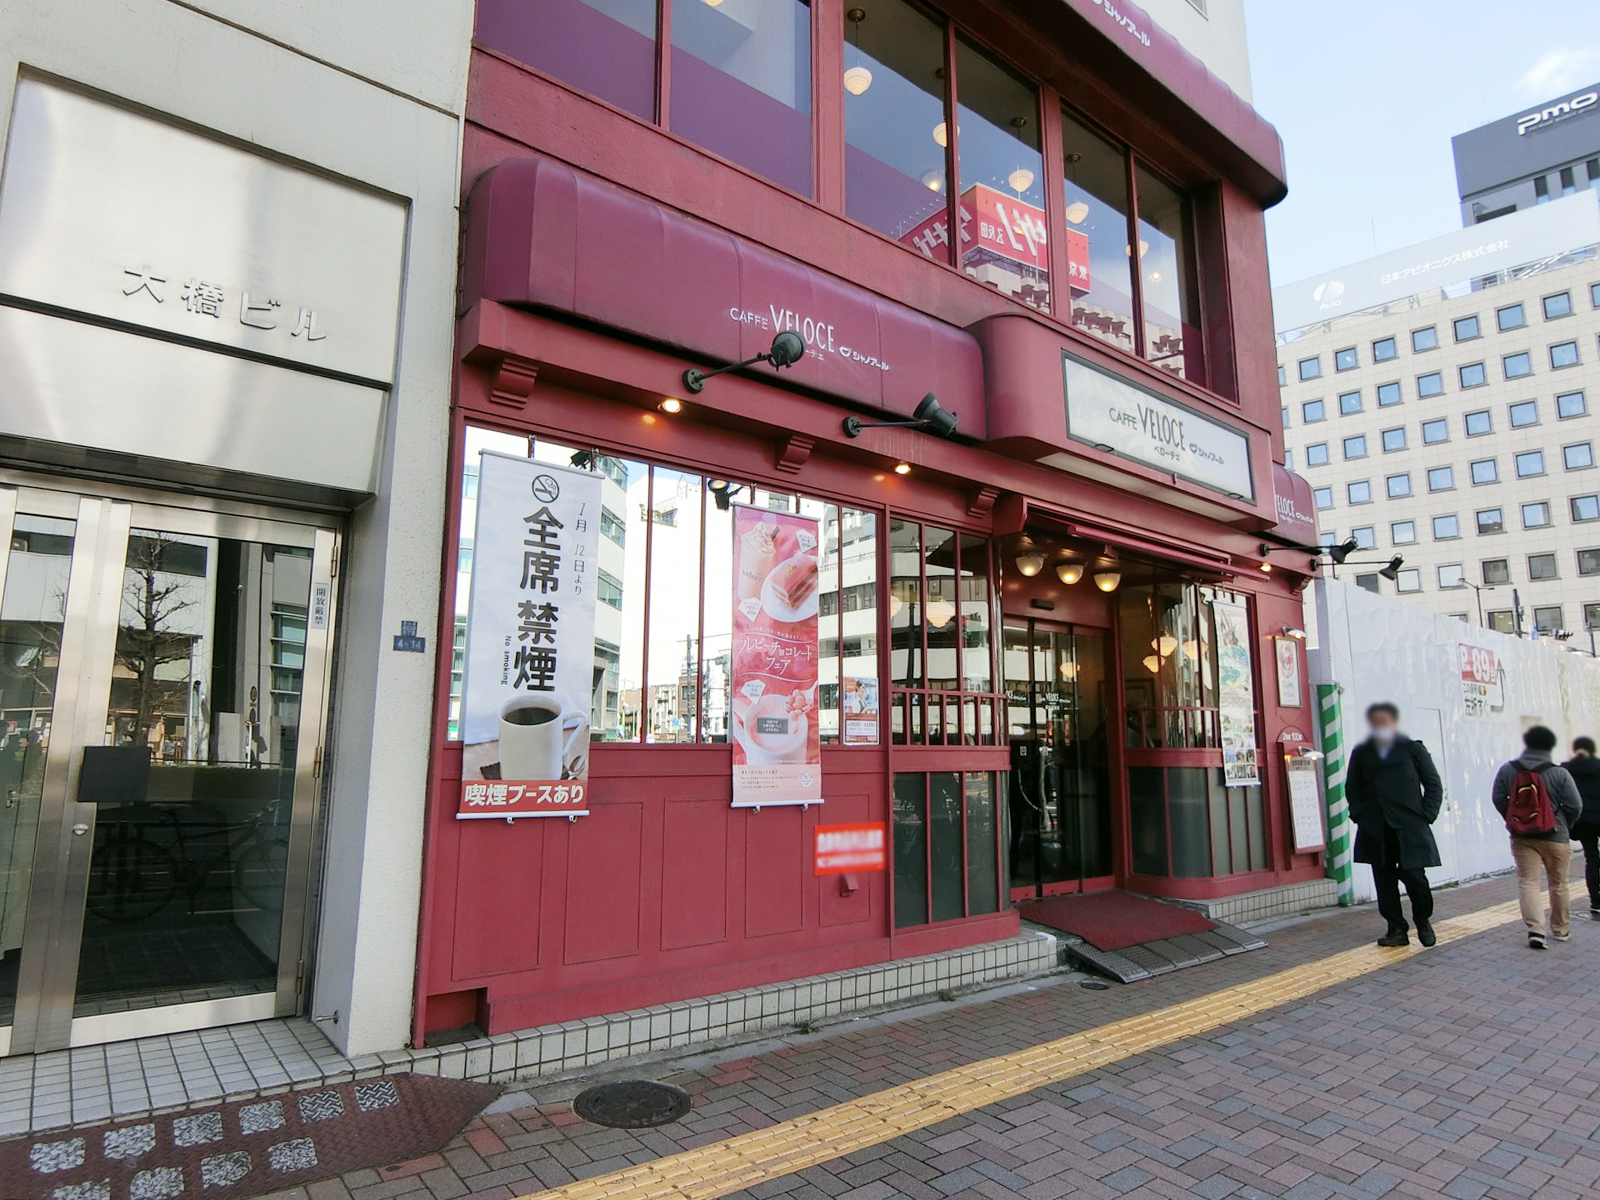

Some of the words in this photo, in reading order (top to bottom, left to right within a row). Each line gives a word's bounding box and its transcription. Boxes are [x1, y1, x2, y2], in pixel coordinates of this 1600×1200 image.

[122, 264, 327, 342] 大橋ビル
[729, 307, 769, 331] CAFFE
[852, 351, 890, 371] シャノアール
[1109, 407, 1138, 431] CAFFE
[1137, 403, 1186, 452] VELOCE
[314, 587, 327, 625] 開放厳禁
[513, 506, 565, 692] 全席禁煙
[504, 635, 511, 647] No
[738, 637, 813, 662] ルビーチョコレート
[501, 650, 510, 685] smoking
[765, 656, 792, 675] フェア
[464, 783, 584, 807] 喫煙ブースあり
